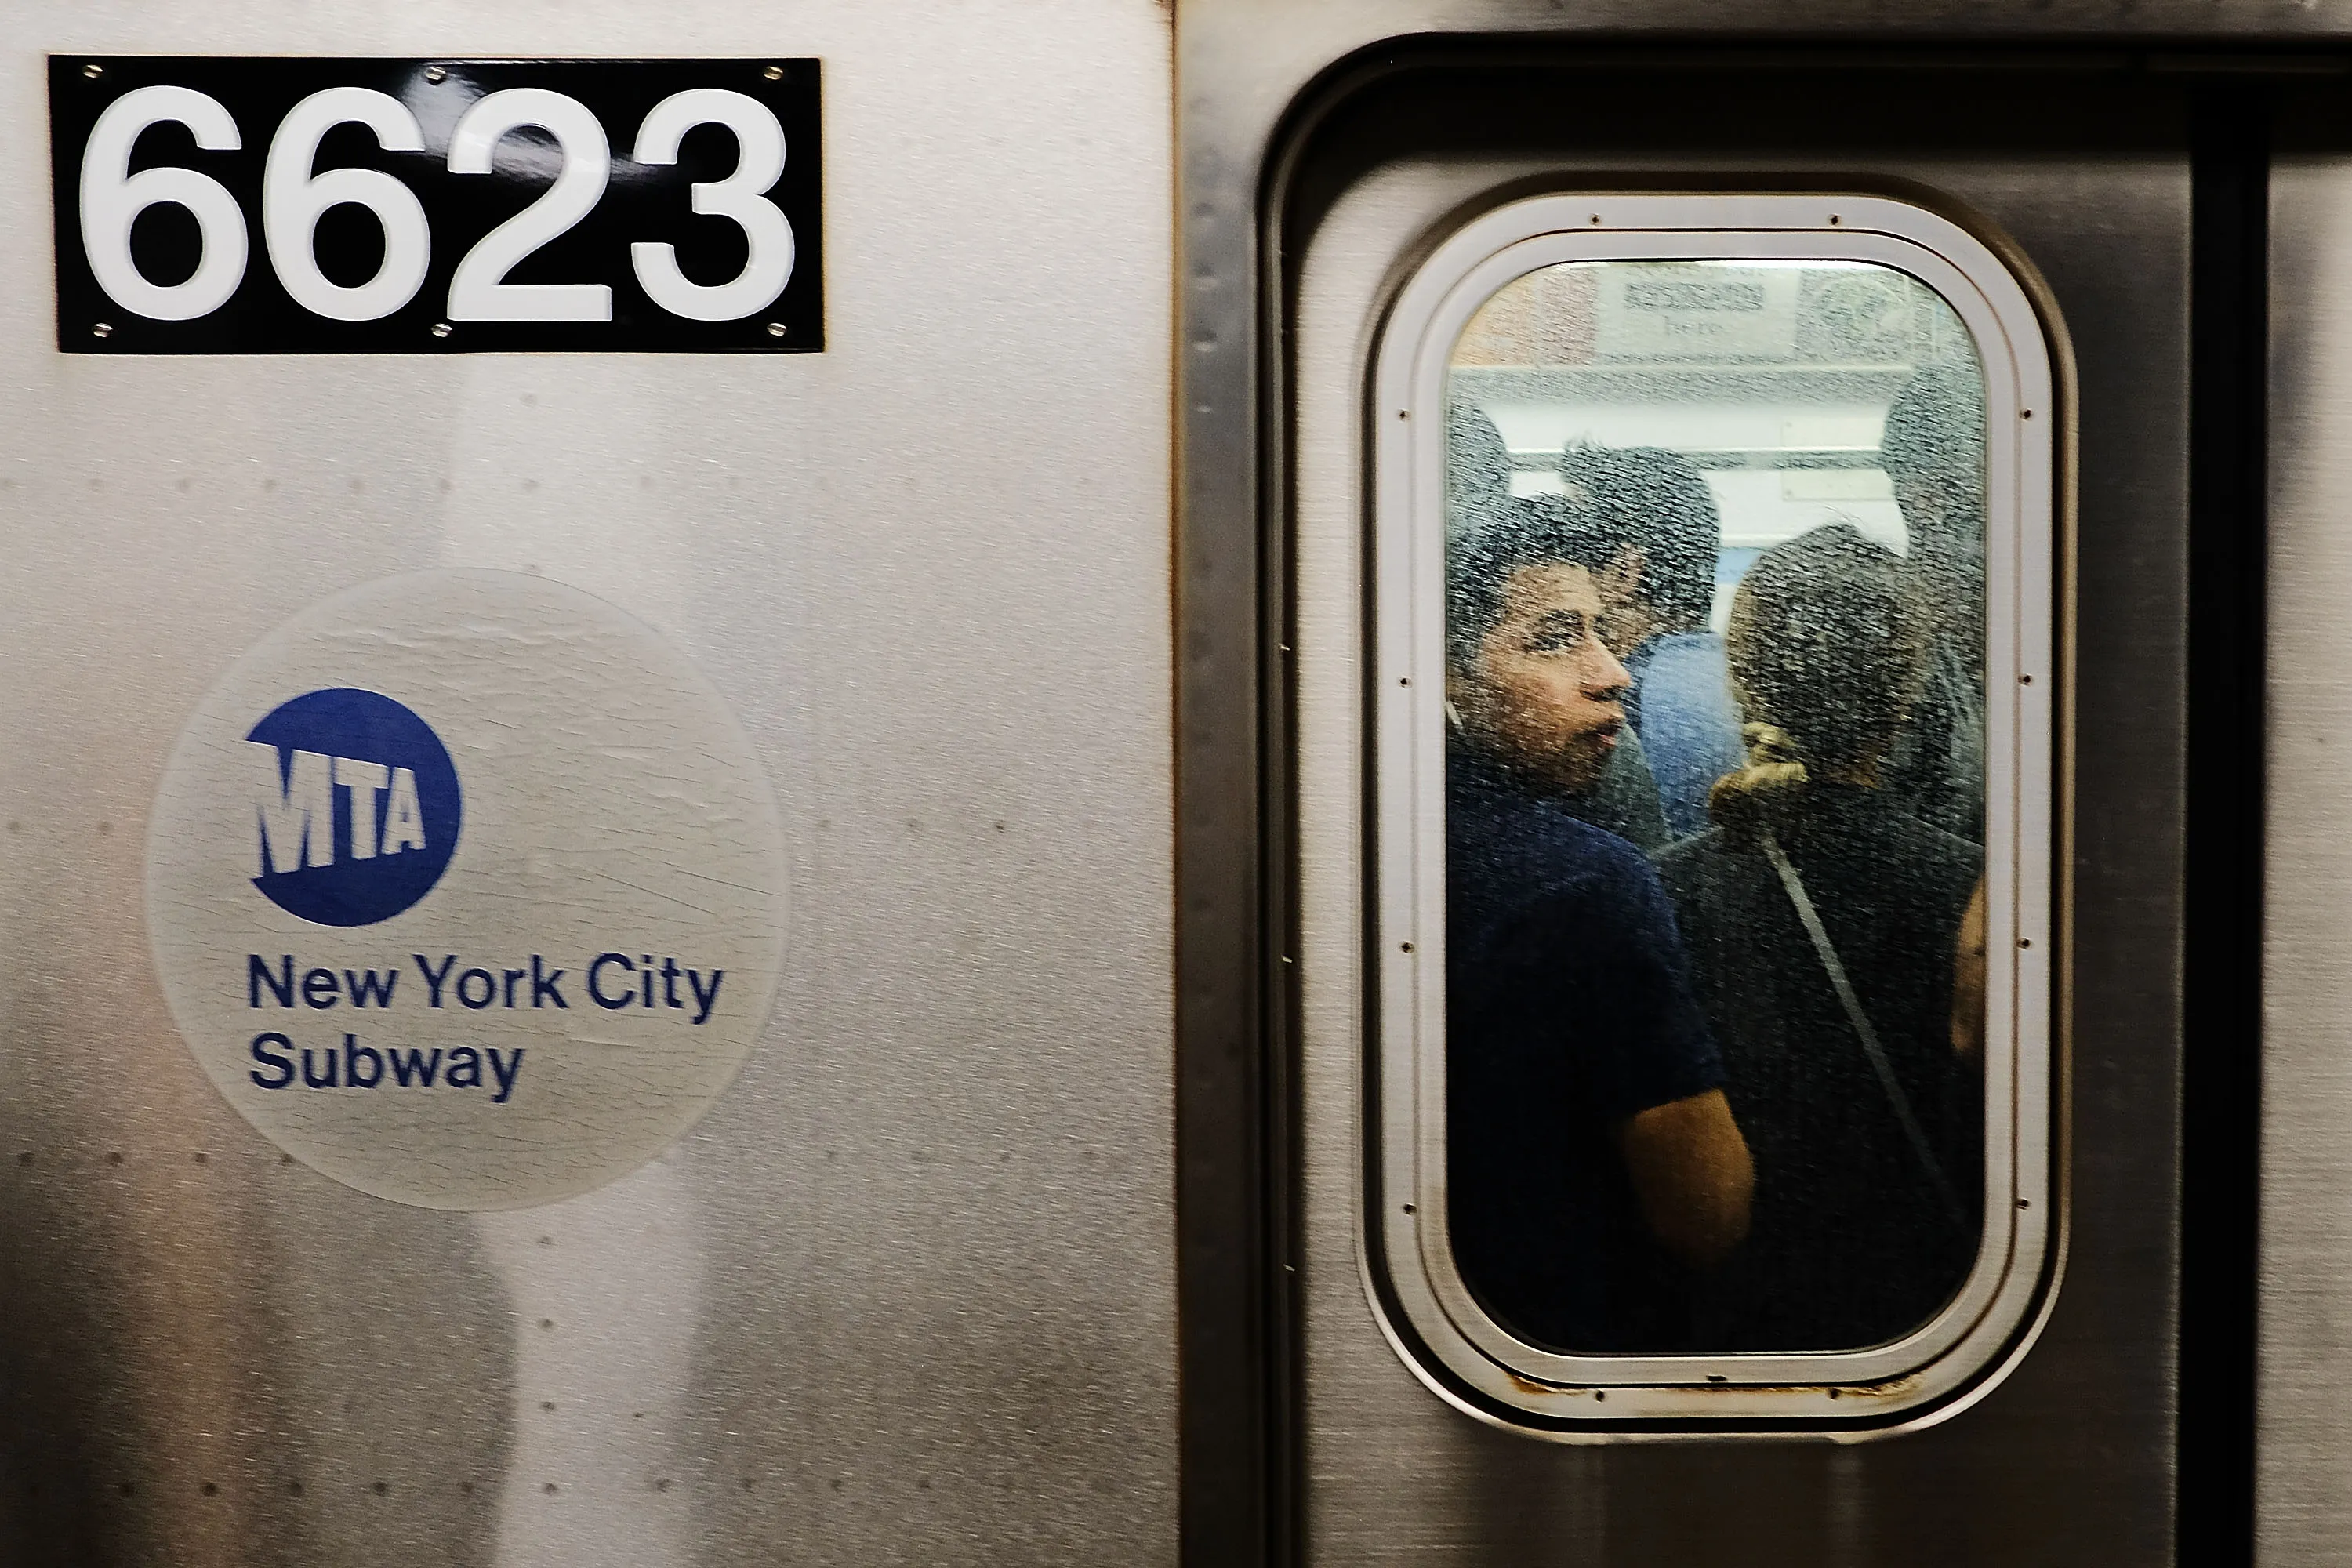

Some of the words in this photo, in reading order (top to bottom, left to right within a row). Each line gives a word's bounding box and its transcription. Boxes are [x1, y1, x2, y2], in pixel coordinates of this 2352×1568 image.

[79, 85, 795, 321] 6623
[243, 739, 427, 879] MTA
[248, 954, 399, 1009] New
[413, 954, 570, 1010] York
[587, 952, 725, 1025] City
[250, 1032, 525, 1103] Subway
